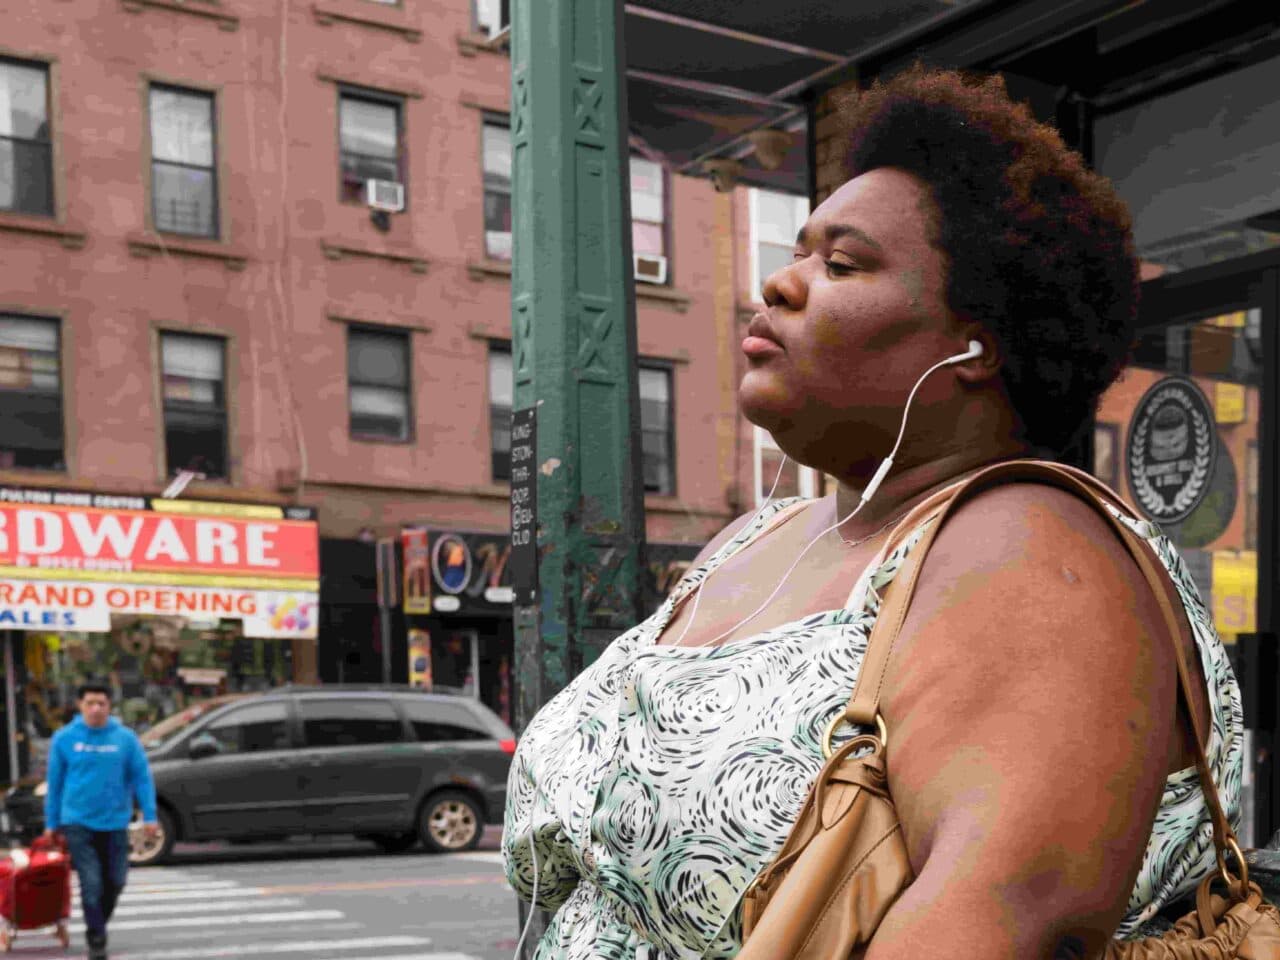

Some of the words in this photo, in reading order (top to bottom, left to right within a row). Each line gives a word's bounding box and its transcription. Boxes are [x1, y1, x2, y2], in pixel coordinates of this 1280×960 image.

[0, 510, 280, 567] DWARE
[0, 583, 94, 608] RAND
[106, 588, 257, 614] OPENING
[0, 610, 75, 626] ALES
